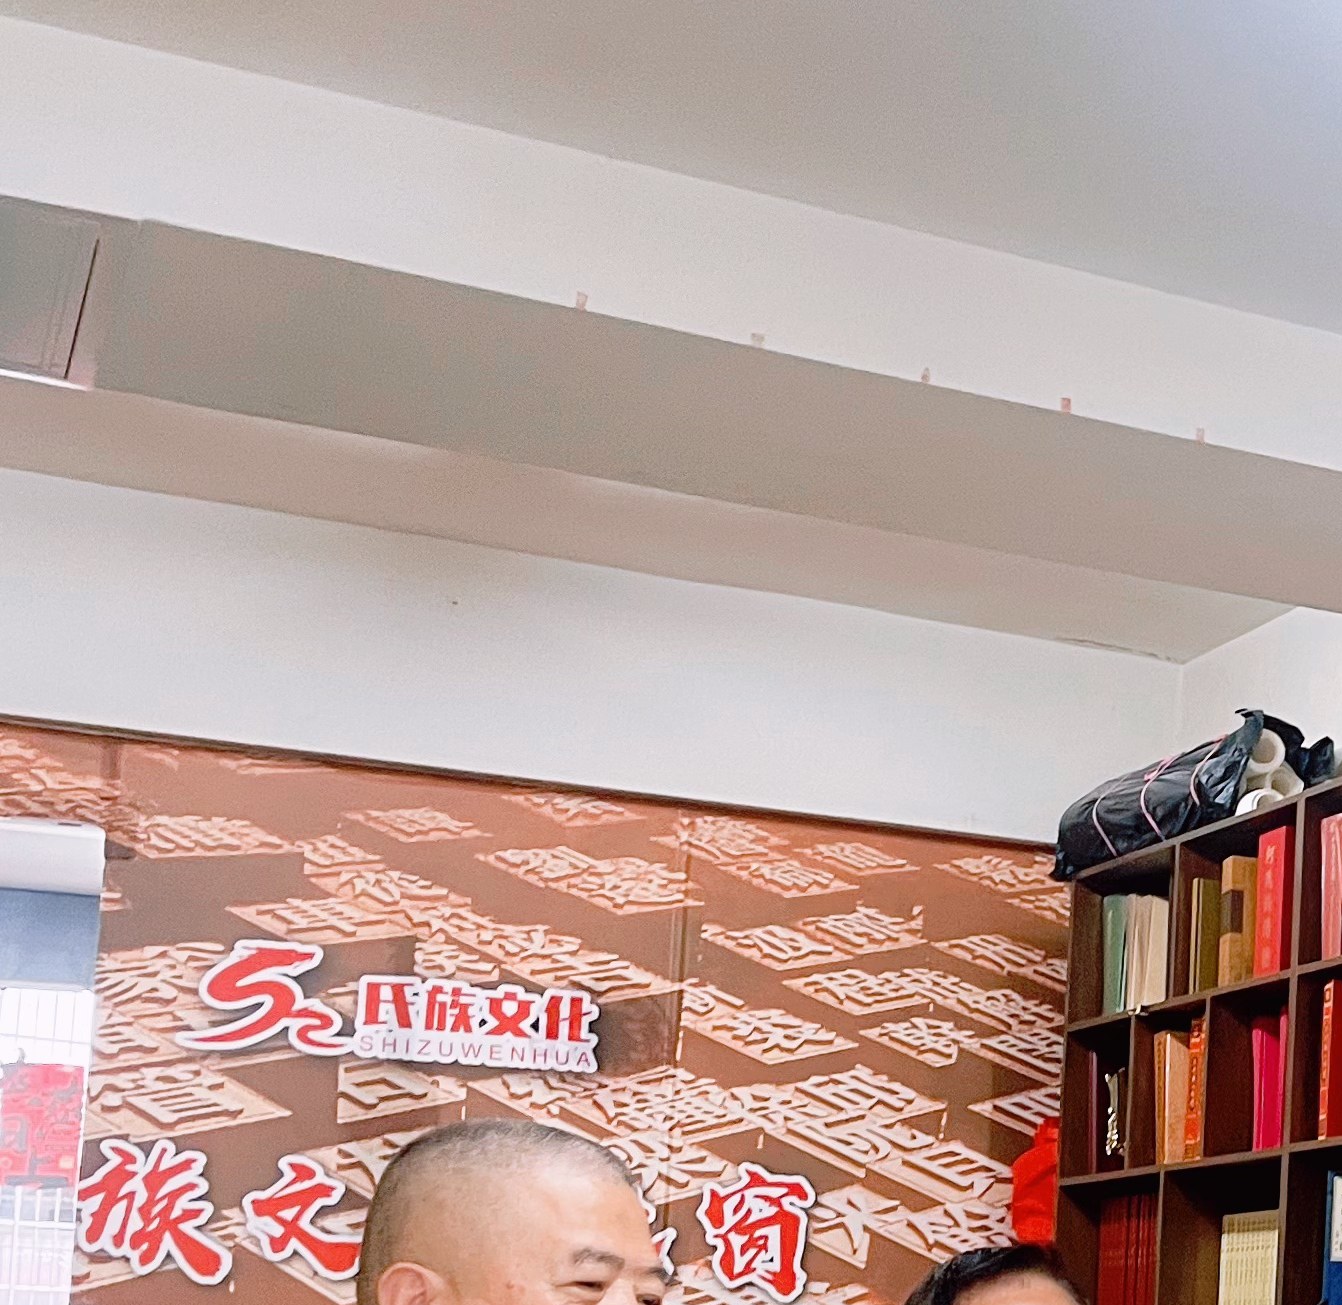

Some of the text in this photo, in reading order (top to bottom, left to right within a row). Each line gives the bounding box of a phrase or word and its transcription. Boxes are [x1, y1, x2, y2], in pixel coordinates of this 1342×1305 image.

[363, 981, 592, 1043] 氏族文化
[360, 1034, 592, 1068] SHIZUWENHUA
